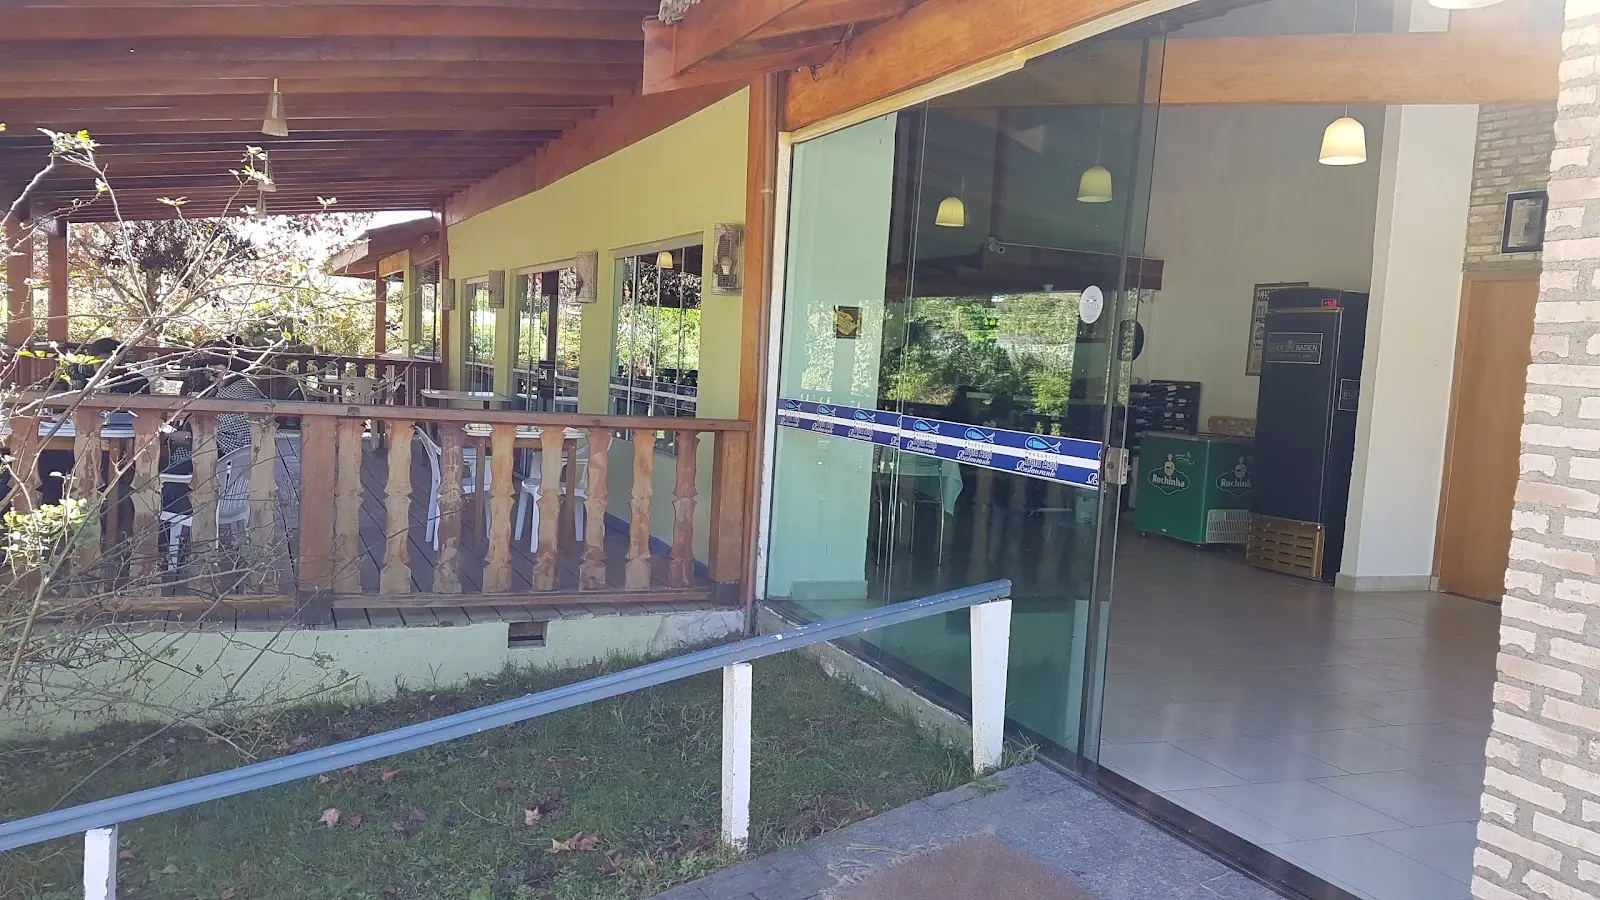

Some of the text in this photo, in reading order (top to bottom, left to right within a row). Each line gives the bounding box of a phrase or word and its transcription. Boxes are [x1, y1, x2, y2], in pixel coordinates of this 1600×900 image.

[1014, 460, 1056, 477] Restaurante
[1152, 473, 1185, 488] Rochinha
[1220, 478, 1252, 488] Rochinh
